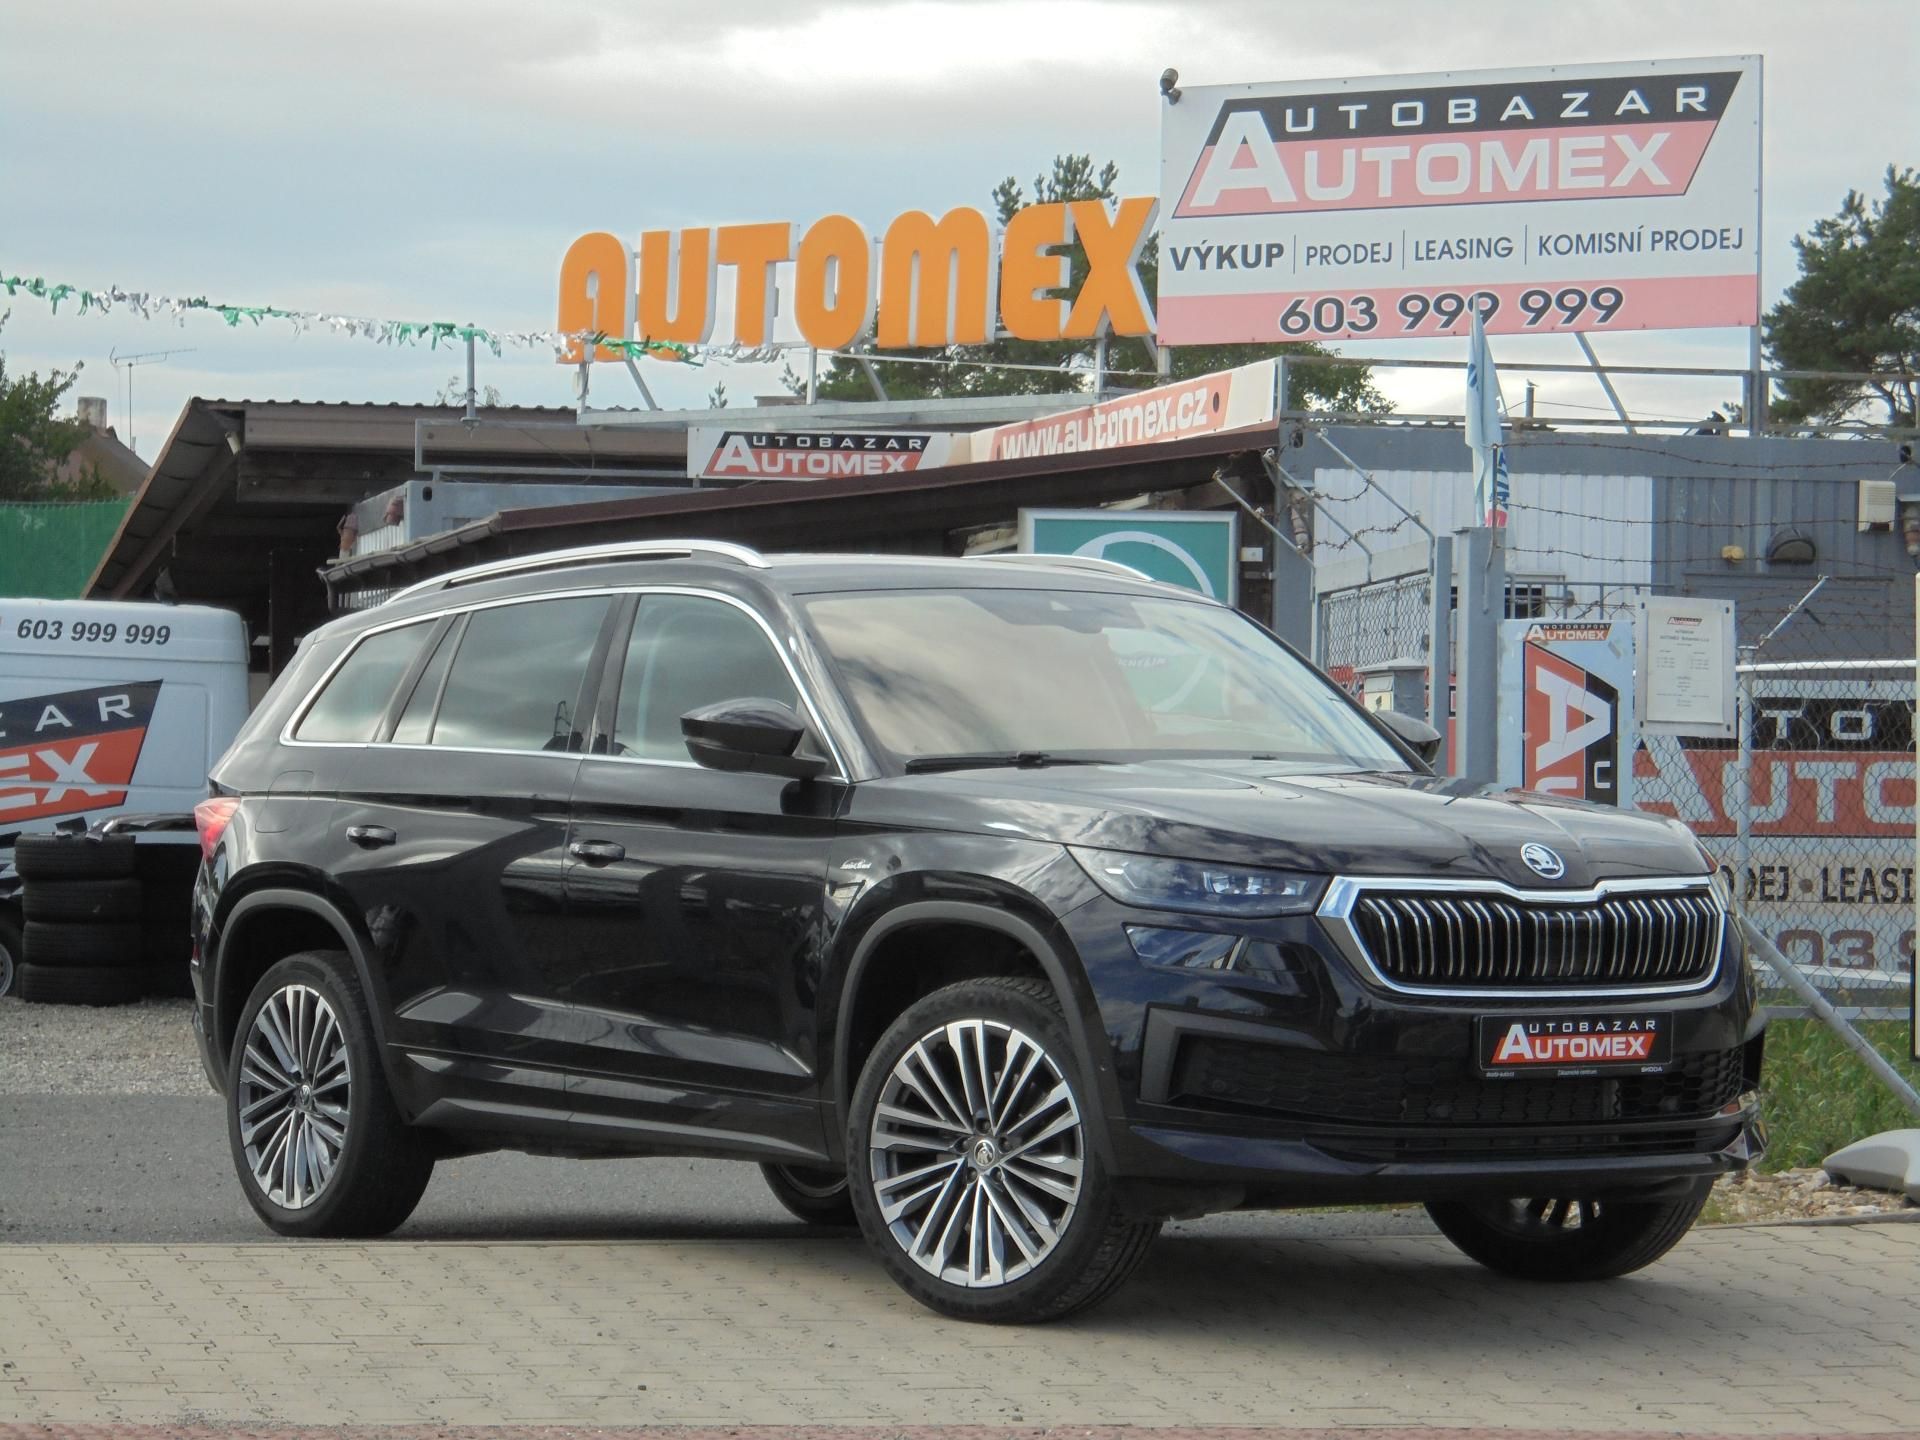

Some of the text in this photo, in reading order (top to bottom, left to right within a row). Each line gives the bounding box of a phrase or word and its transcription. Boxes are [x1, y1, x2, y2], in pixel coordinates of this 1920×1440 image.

[1190, 110, 1672, 208] AUTOMEX
[1169, 225, 1744, 271] VÝKUP PRODEJ LEASING KOMISNÍ PRODEJ
[558, 197, 1157, 363] AUTOMEX
[1279, 286, 1624, 336] 603 999 999
[1002, 387, 1208, 461] www.automex.cz
[714, 435, 907, 475] AUTOMEX
[17, 619, 171, 645] 603 999 999
[1527, 624, 1605, 640] AUTOMEX
[0, 694, 135, 738] AR
[1498, 1024, 1645, 1060] AUTOMEX
